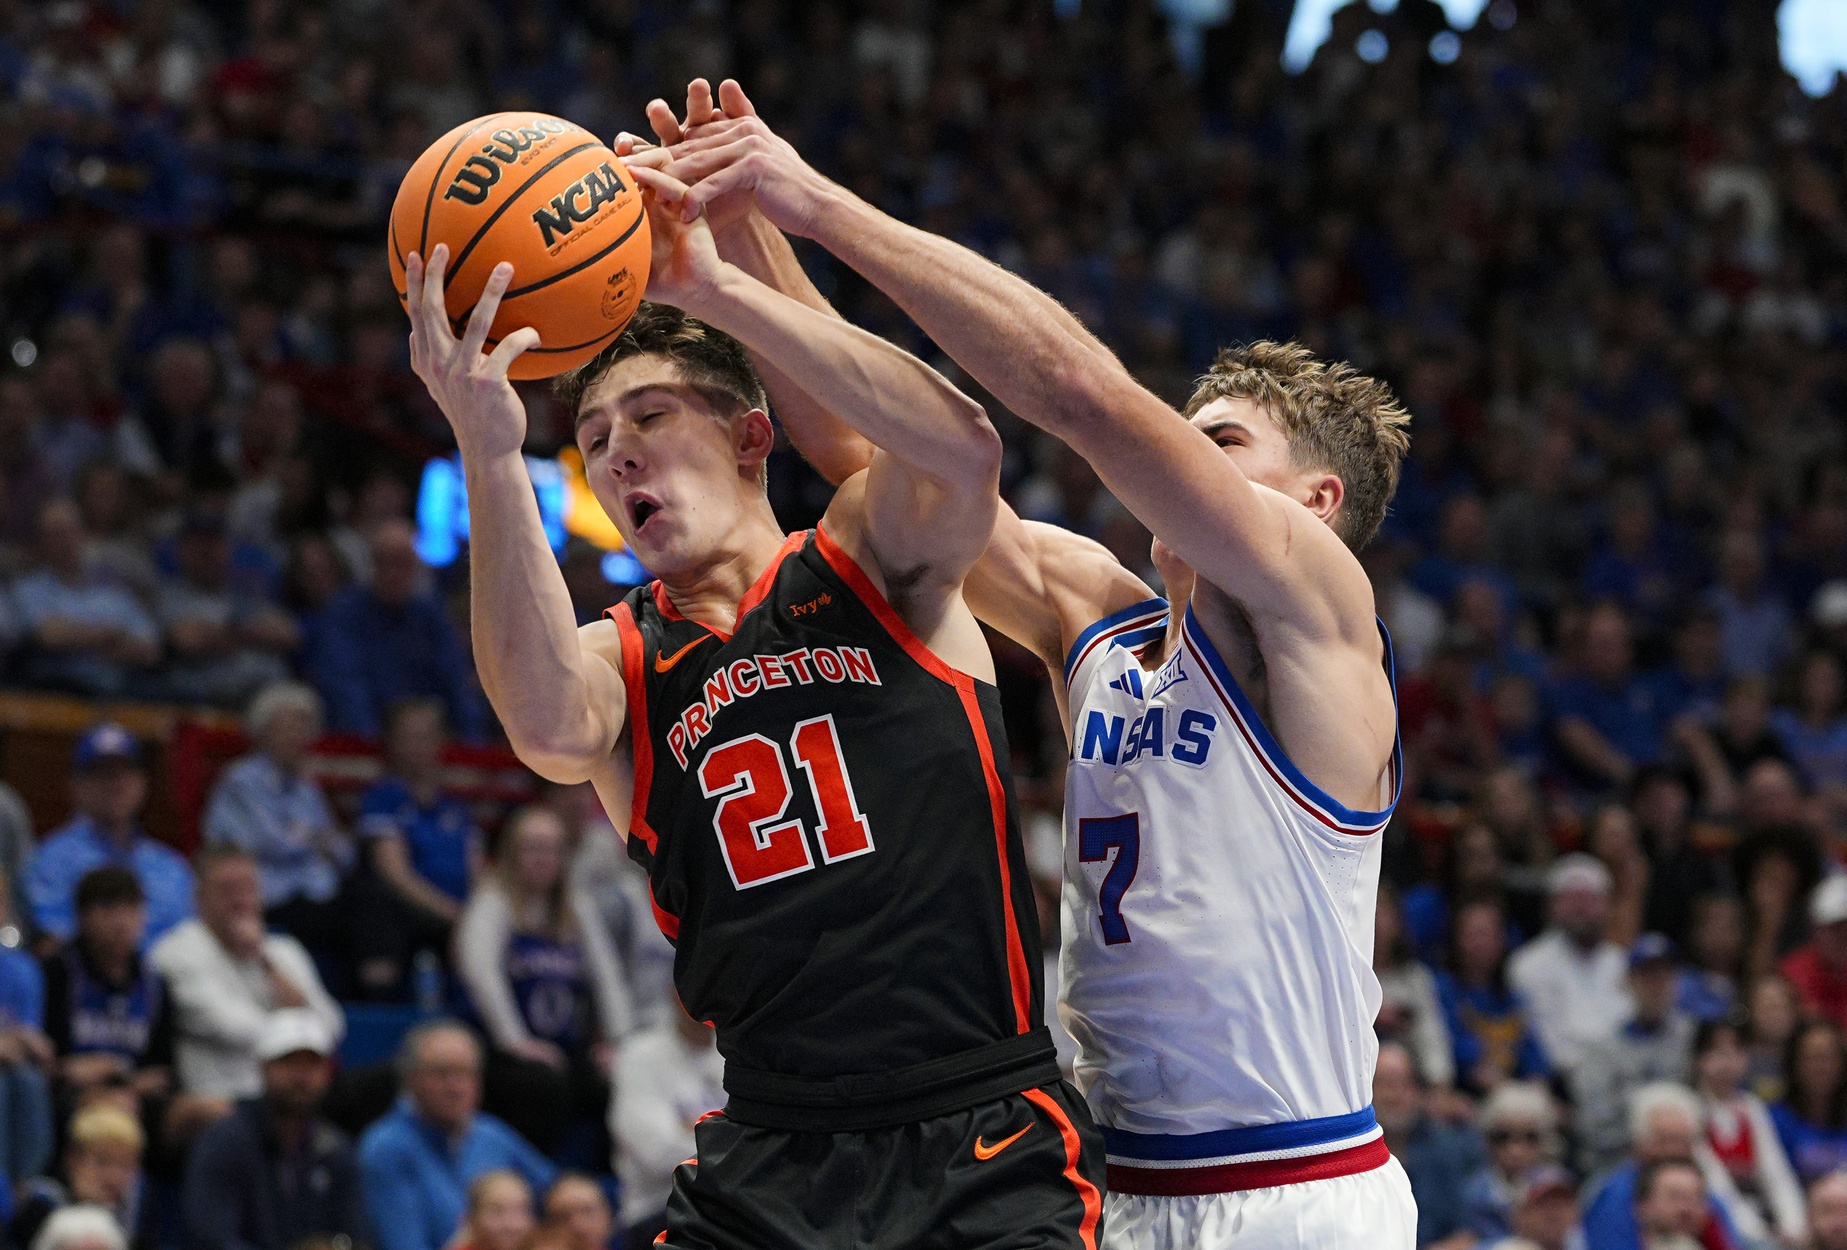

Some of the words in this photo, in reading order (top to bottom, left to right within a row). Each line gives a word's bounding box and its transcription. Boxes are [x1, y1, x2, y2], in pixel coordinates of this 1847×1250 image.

[531, 161, 628, 252] NCAA
[550, 226, 594, 257] OFFICIAL
[593, 207, 617, 226] GAME
[789, 599, 818, 617] Ivy
[667, 646, 882, 772] PRNCETON
[1079, 706, 1218, 767] NSAS
[697, 713, 876, 891] 21
[1078, 811, 1140, 946] 7
